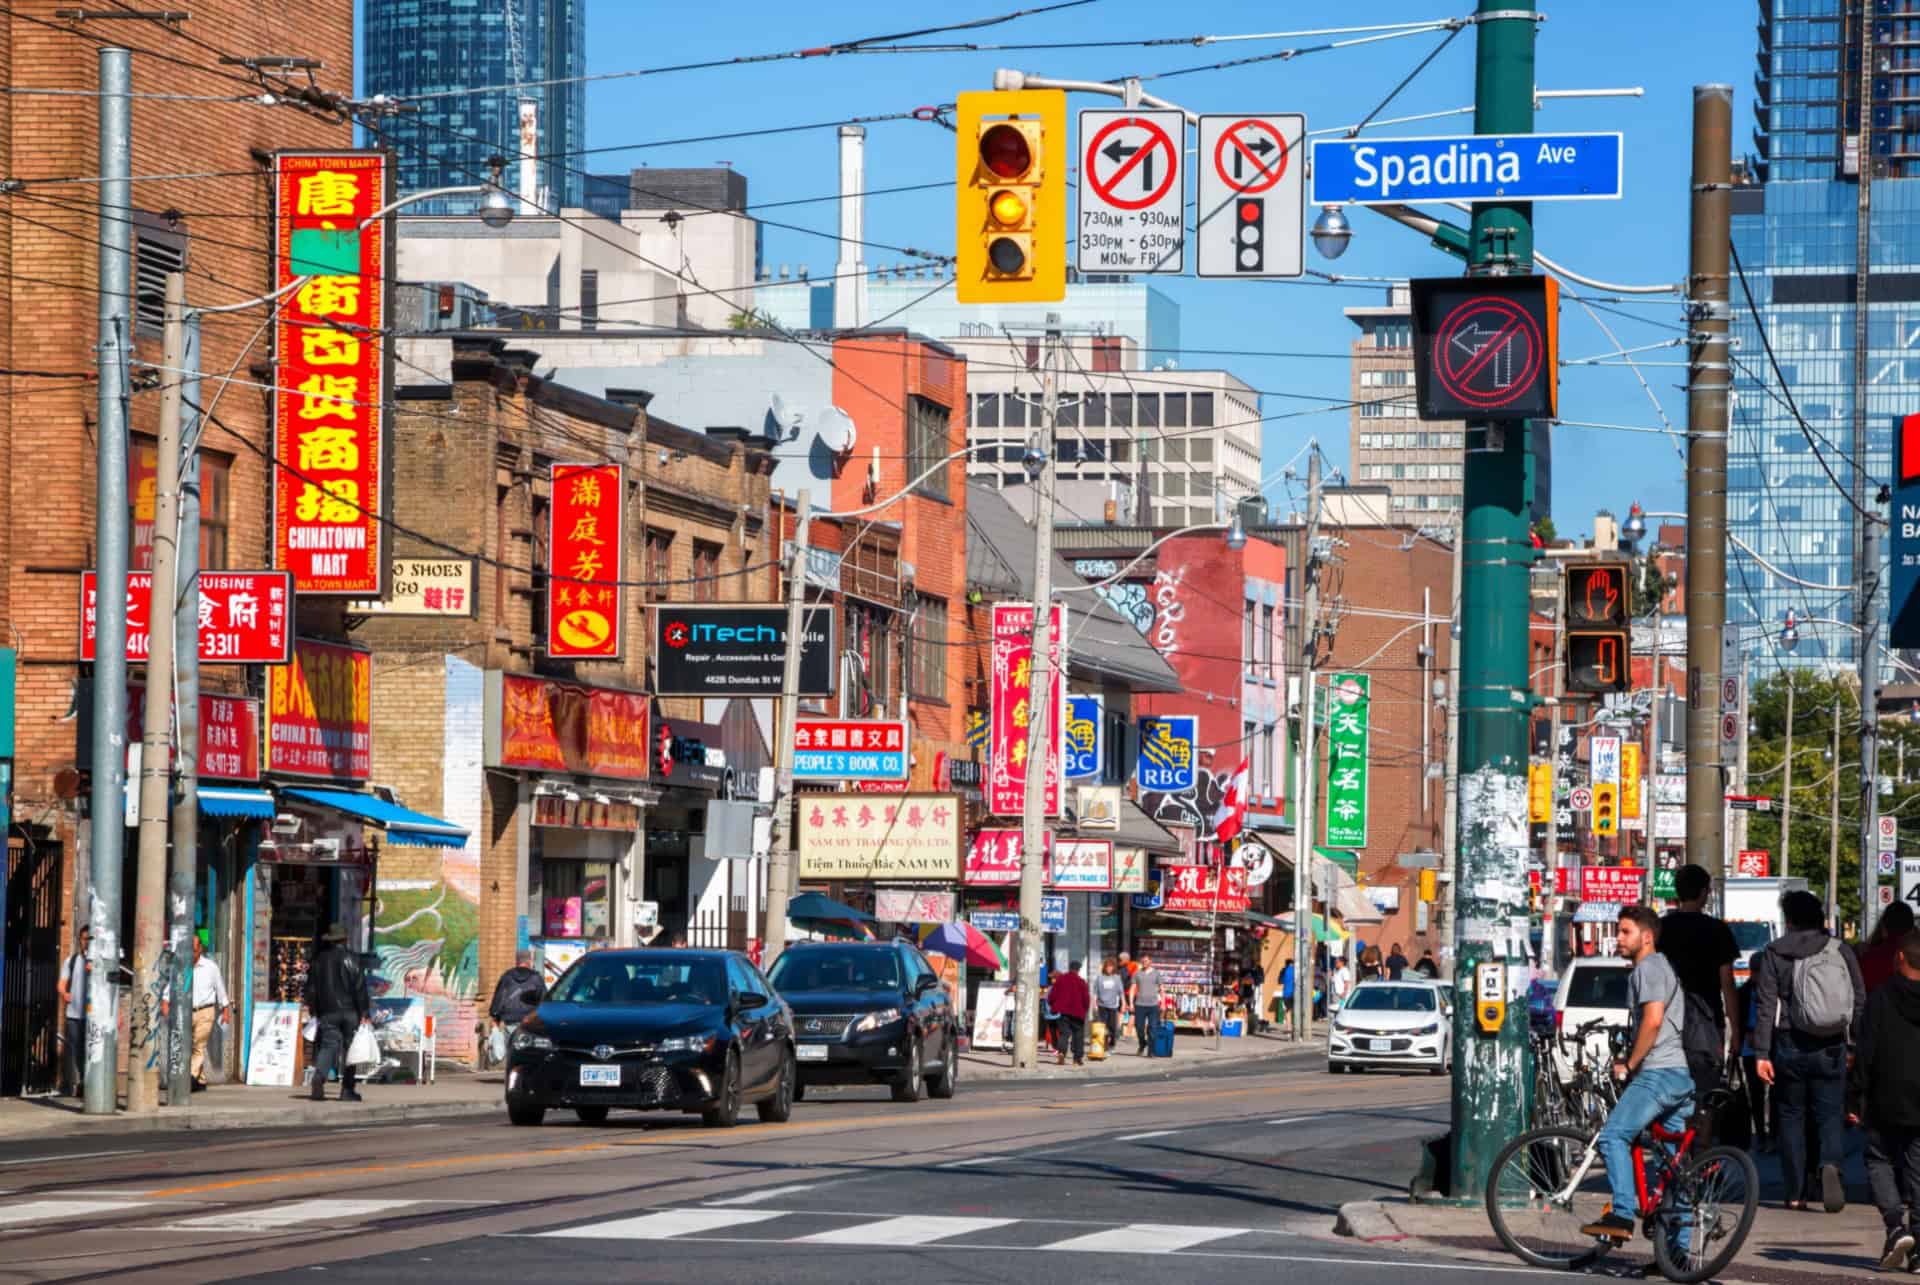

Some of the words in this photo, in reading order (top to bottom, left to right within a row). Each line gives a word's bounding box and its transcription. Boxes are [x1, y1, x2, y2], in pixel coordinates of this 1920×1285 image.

[288, 158, 317, 168] CHINA
[319, 158, 347, 168] TOWN
[349, 158, 375, 168] MART
[1354, 144, 1521, 196] Spadina
[1537, 143, 1576, 164] Ave
[1084, 211, 1123, 227] 730AM
[1140, 211, 1180, 227] 930AM
[1082, 234, 1123, 250] 330PM
[1140, 234, 1182, 250] 630PM
[1101, 252, 1127, 265] MON
[1140, 252, 1161, 265] FRI
[567, 474, 606, 582] 滿庭芳
[289, 527, 366, 549] CHINATOWN
[311, 553, 349, 576] MART
[410, 563, 463, 577] SHOES
[692, 623, 775, 643] iTech
[685, 653, 710, 663] Repair
[716, 652, 761, 663] Accessories
[728, 675, 760, 685] Dundas
[761, 675, 771, 685] St
[772, 675, 782, 685] W
[272, 722, 305, 745] CHINA
[794, 753, 844, 770] PEOPLE'S
[848, 755, 879, 771] BOOK
[1065, 754, 1094, 771] BC
[1333, 713, 1363, 821] 天仁茗茶
[1144, 769, 1189, 785] RBC
[808, 838, 832, 848] NAM
[898, 858, 928, 869] NAM
